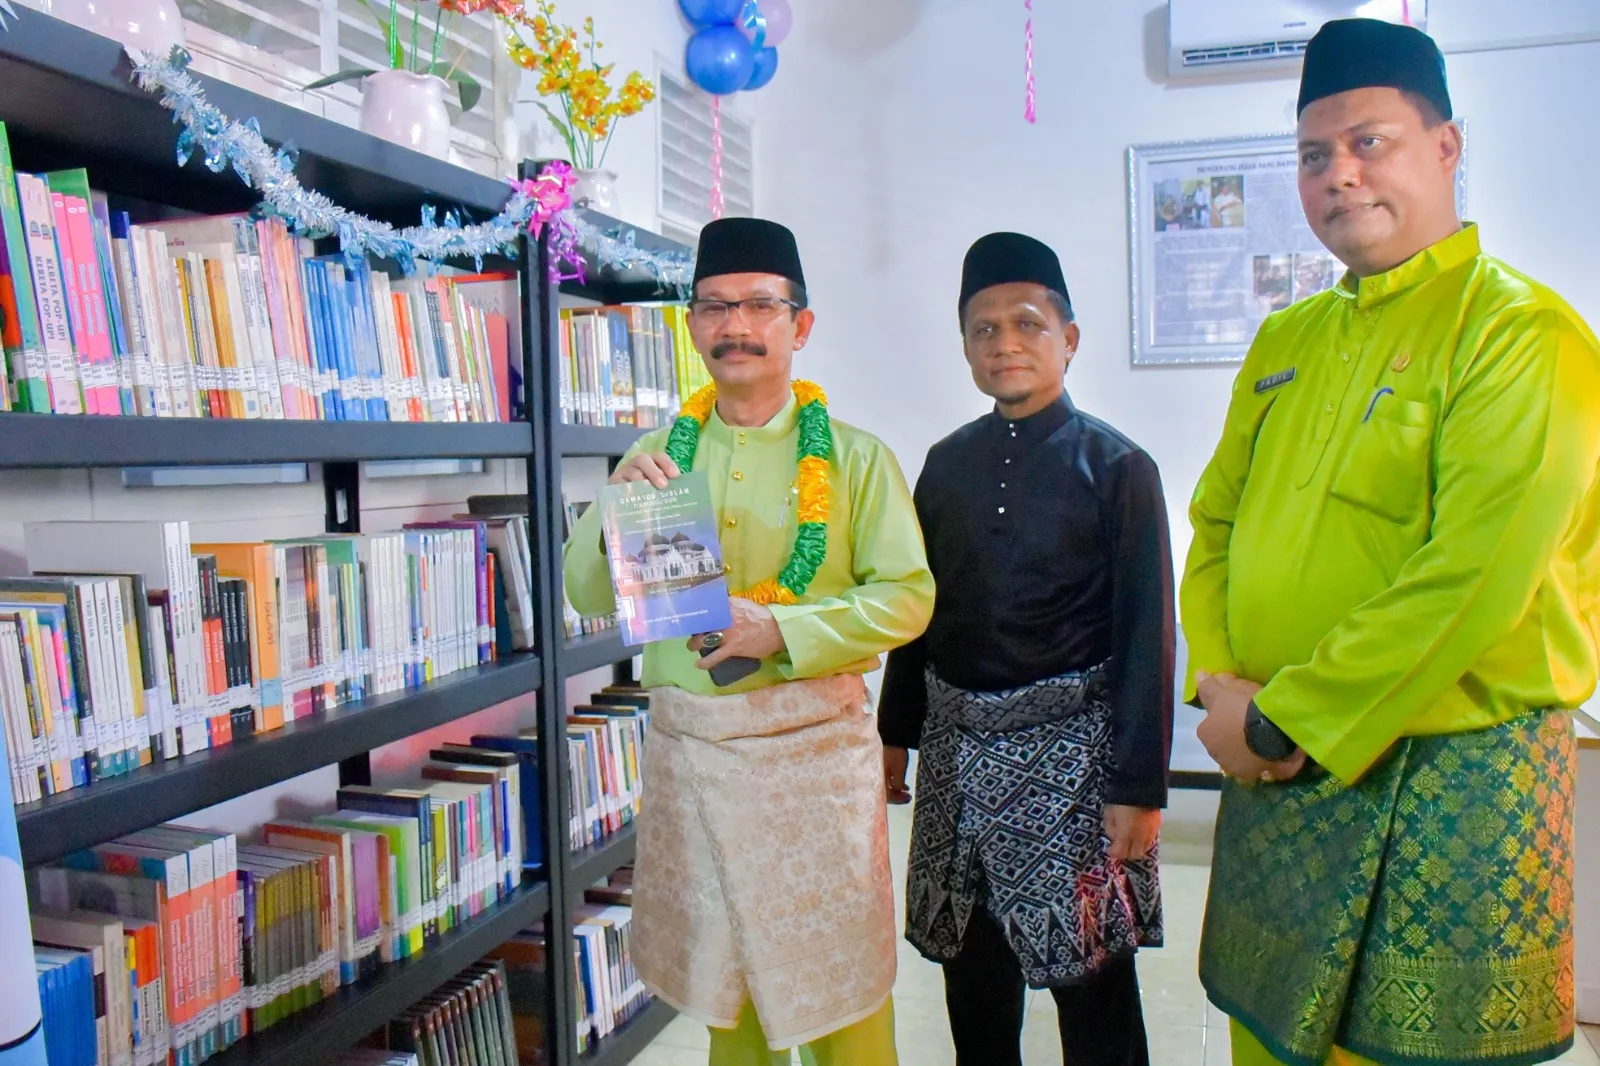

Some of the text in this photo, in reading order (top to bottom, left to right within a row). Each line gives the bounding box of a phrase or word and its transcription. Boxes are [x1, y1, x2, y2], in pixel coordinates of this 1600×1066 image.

[36, 255, 47, 294] KERETA
[46, 258, 58, 297] KERETA
[265, 601, 275, 645] ISLAM
